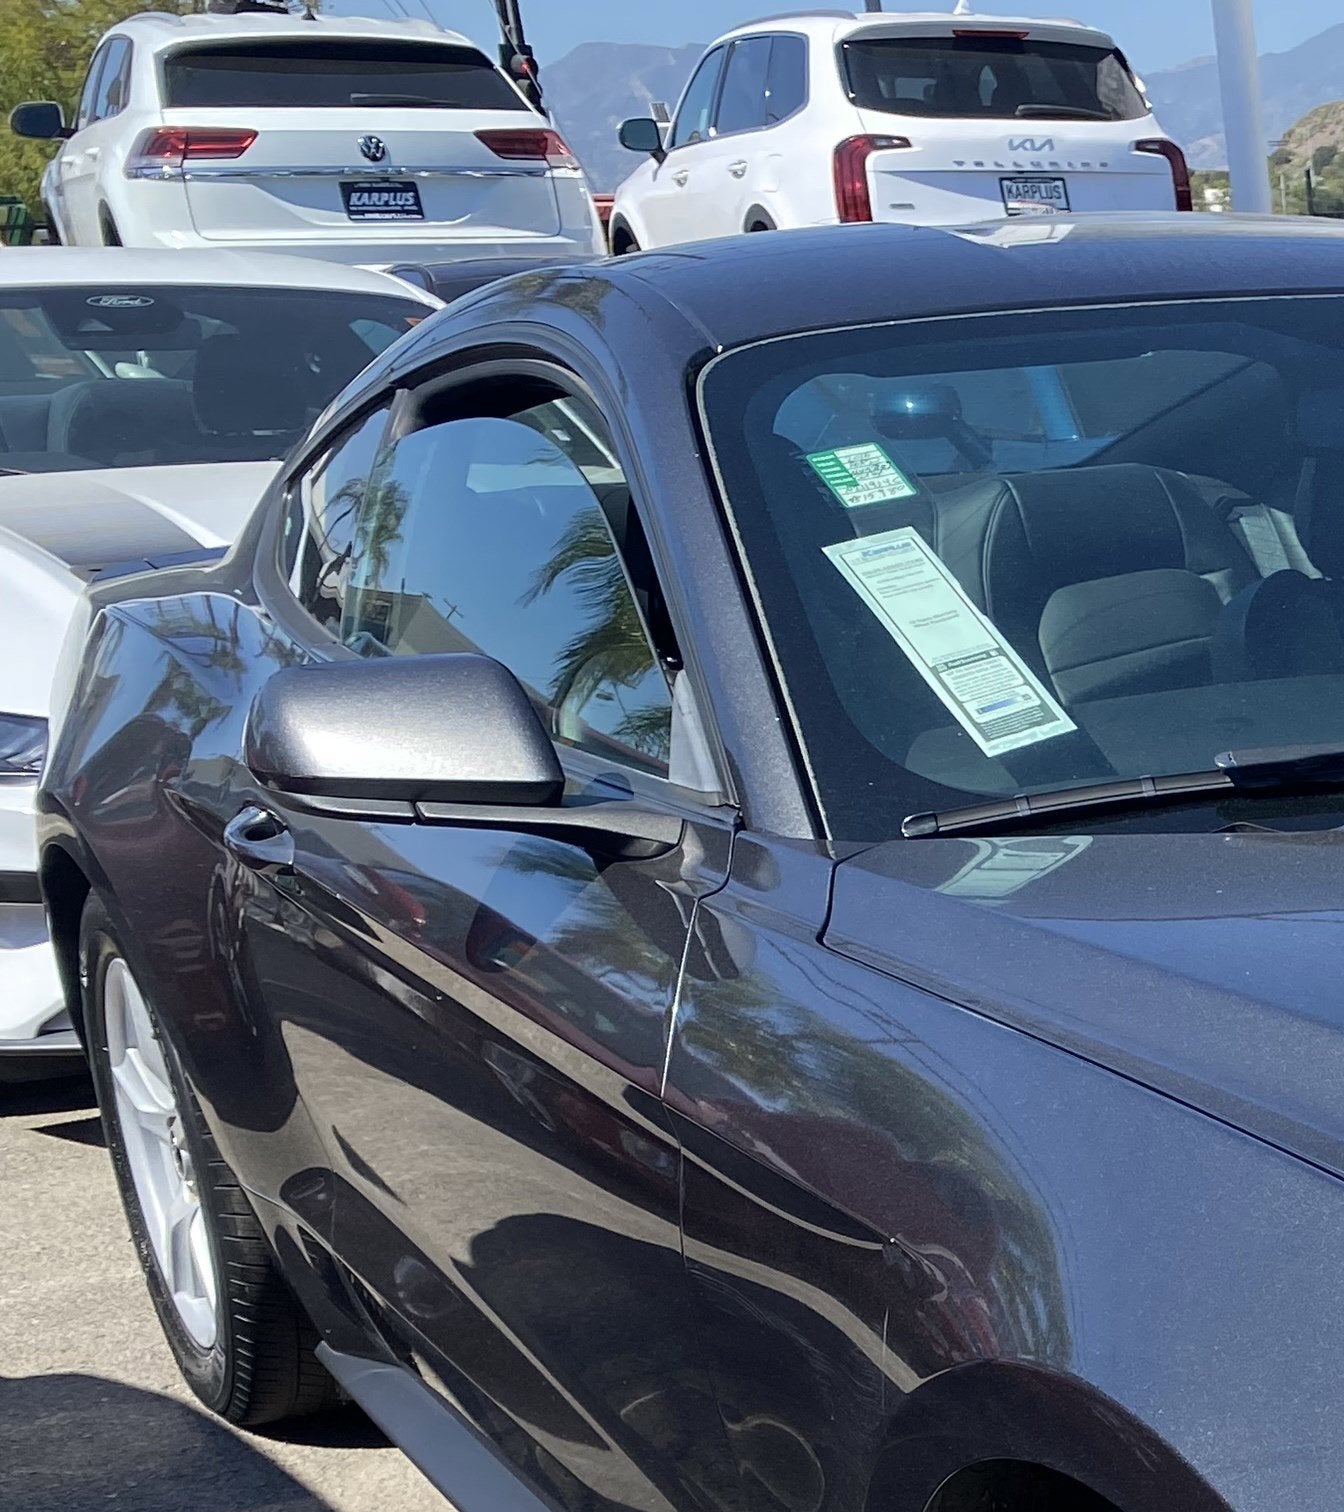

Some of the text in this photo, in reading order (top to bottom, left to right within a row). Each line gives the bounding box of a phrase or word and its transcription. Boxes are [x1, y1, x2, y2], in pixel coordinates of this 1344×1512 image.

[1008, 138, 1055, 151] KIA
[349, 191, 416, 206] KARPLUS
[1005, 184, 1062, 200] KARPLUS
